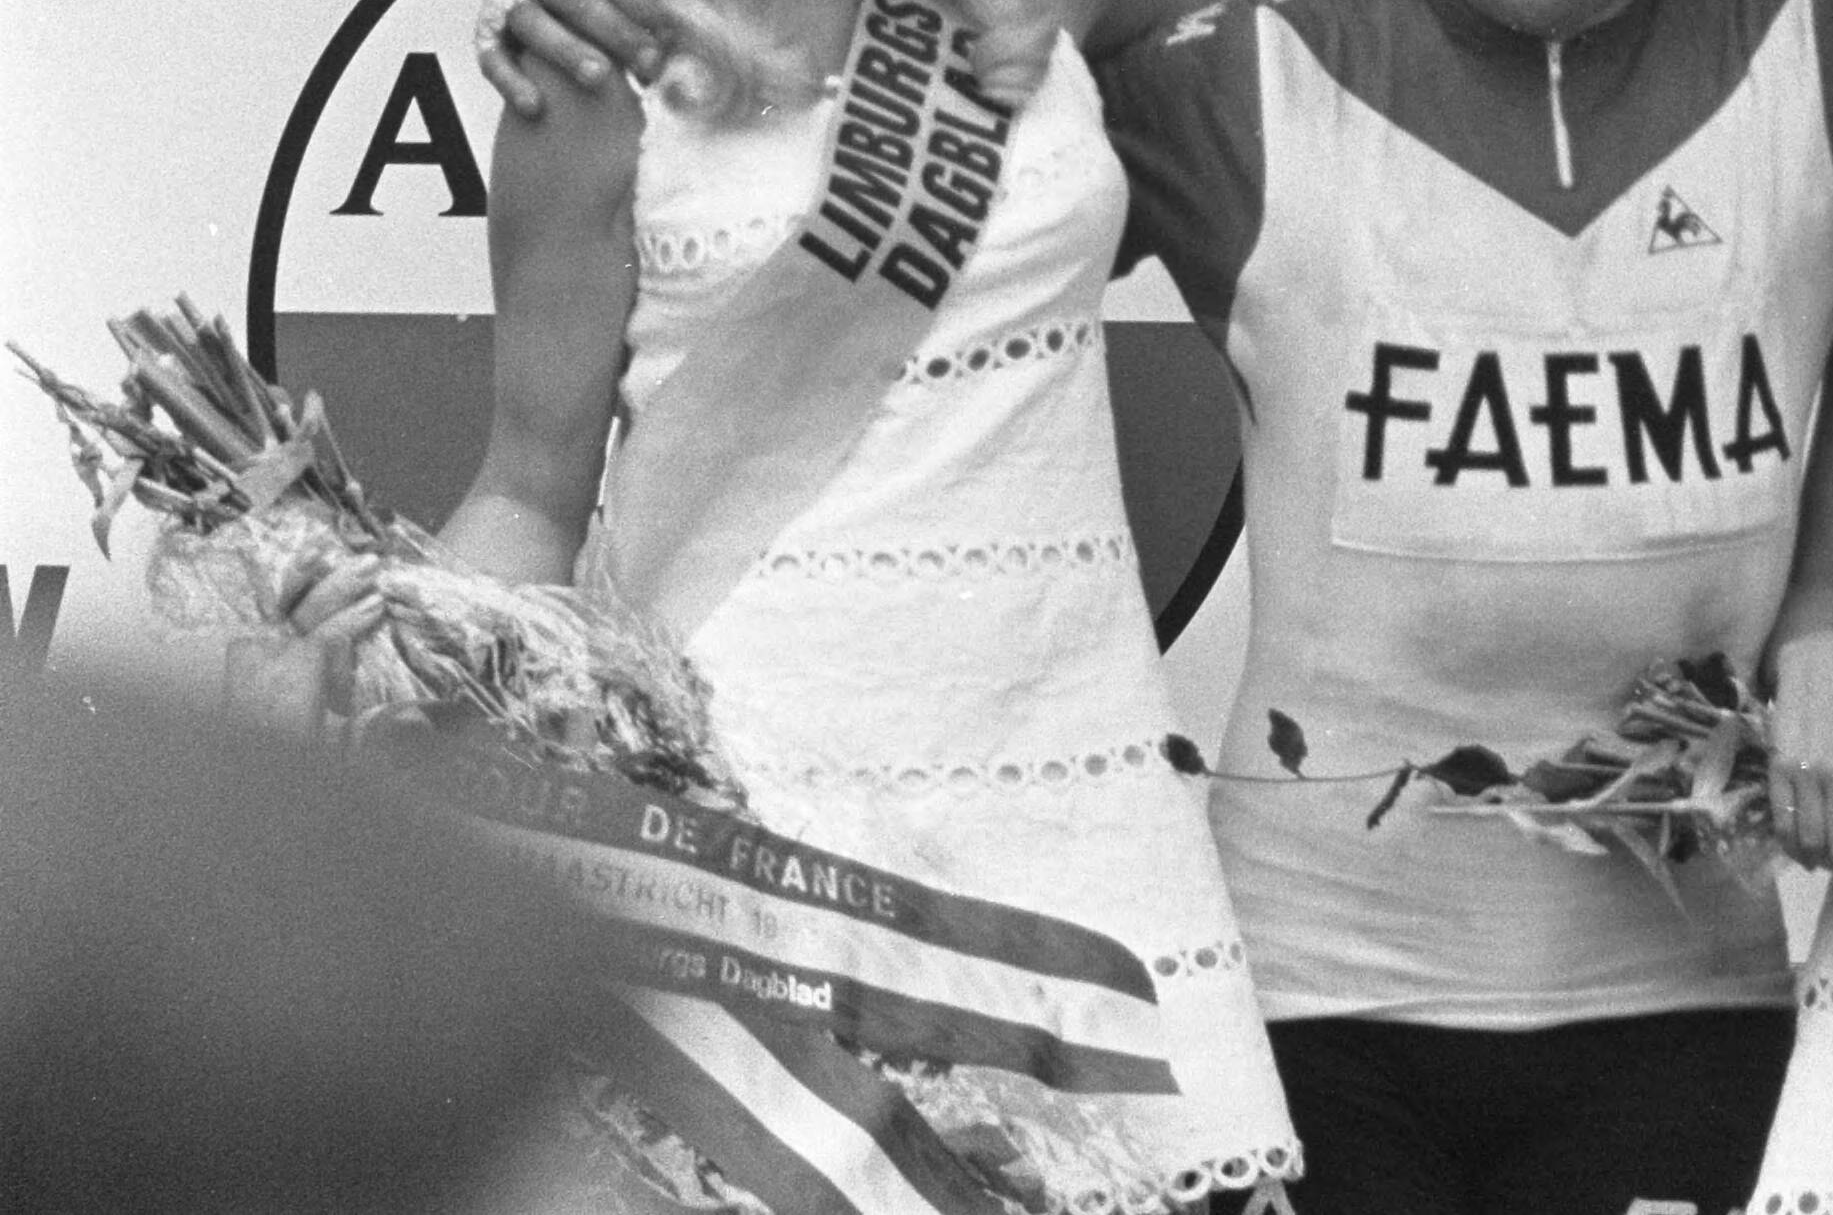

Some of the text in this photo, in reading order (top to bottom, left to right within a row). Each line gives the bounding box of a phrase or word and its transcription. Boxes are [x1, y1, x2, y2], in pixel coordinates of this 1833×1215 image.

[1344, 332, 1792, 488] FAEMA
[639, 802, 698, 854] DE
[728, 834, 898, 919] FRANCE
[719, 953, 833, 1013] Dagblad
